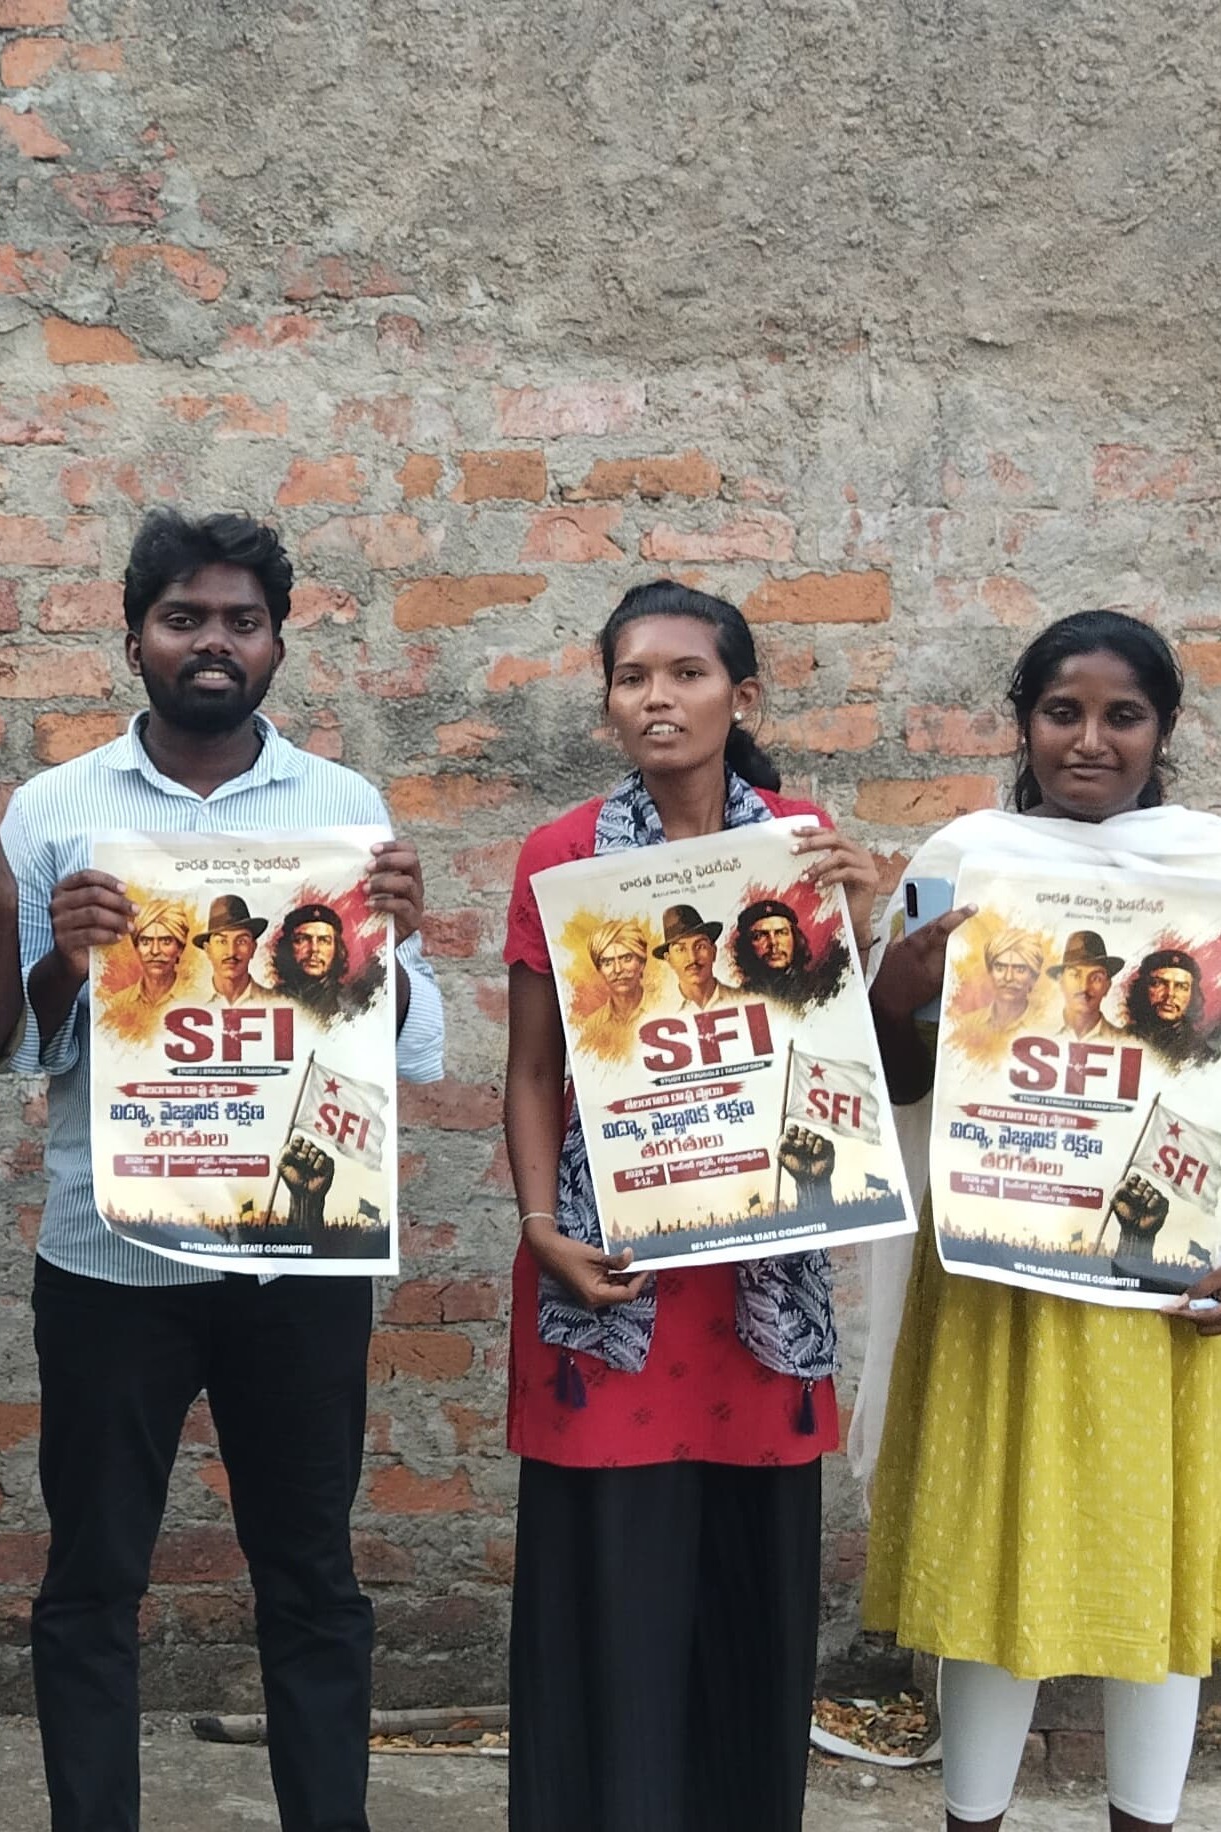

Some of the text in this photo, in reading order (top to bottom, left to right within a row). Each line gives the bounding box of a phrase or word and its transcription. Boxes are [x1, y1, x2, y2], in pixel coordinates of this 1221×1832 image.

[164, 1007, 294, 1063] SFI
[639, 1003, 774, 1073] SFI
[1009, 1035, 1143, 1100] SFI
[806, 1088, 862, 1130] SFI
[144, 1130, 228, 1147] తరగతులు
[313, 1102, 371, 1152] SFI
[641, 1133, 724, 1158] తరగతులు
[980, 1152, 1063, 1177] తరగతులు
[1152, 1143, 1209, 1195] SFI
[240, 1244, 263, 1254] STATE
[264, 1244, 313, 1255] COMMITTEE
[754, 1230, 777, 1241] STATE
[1070, 1271, 1091, 1282] STATE
